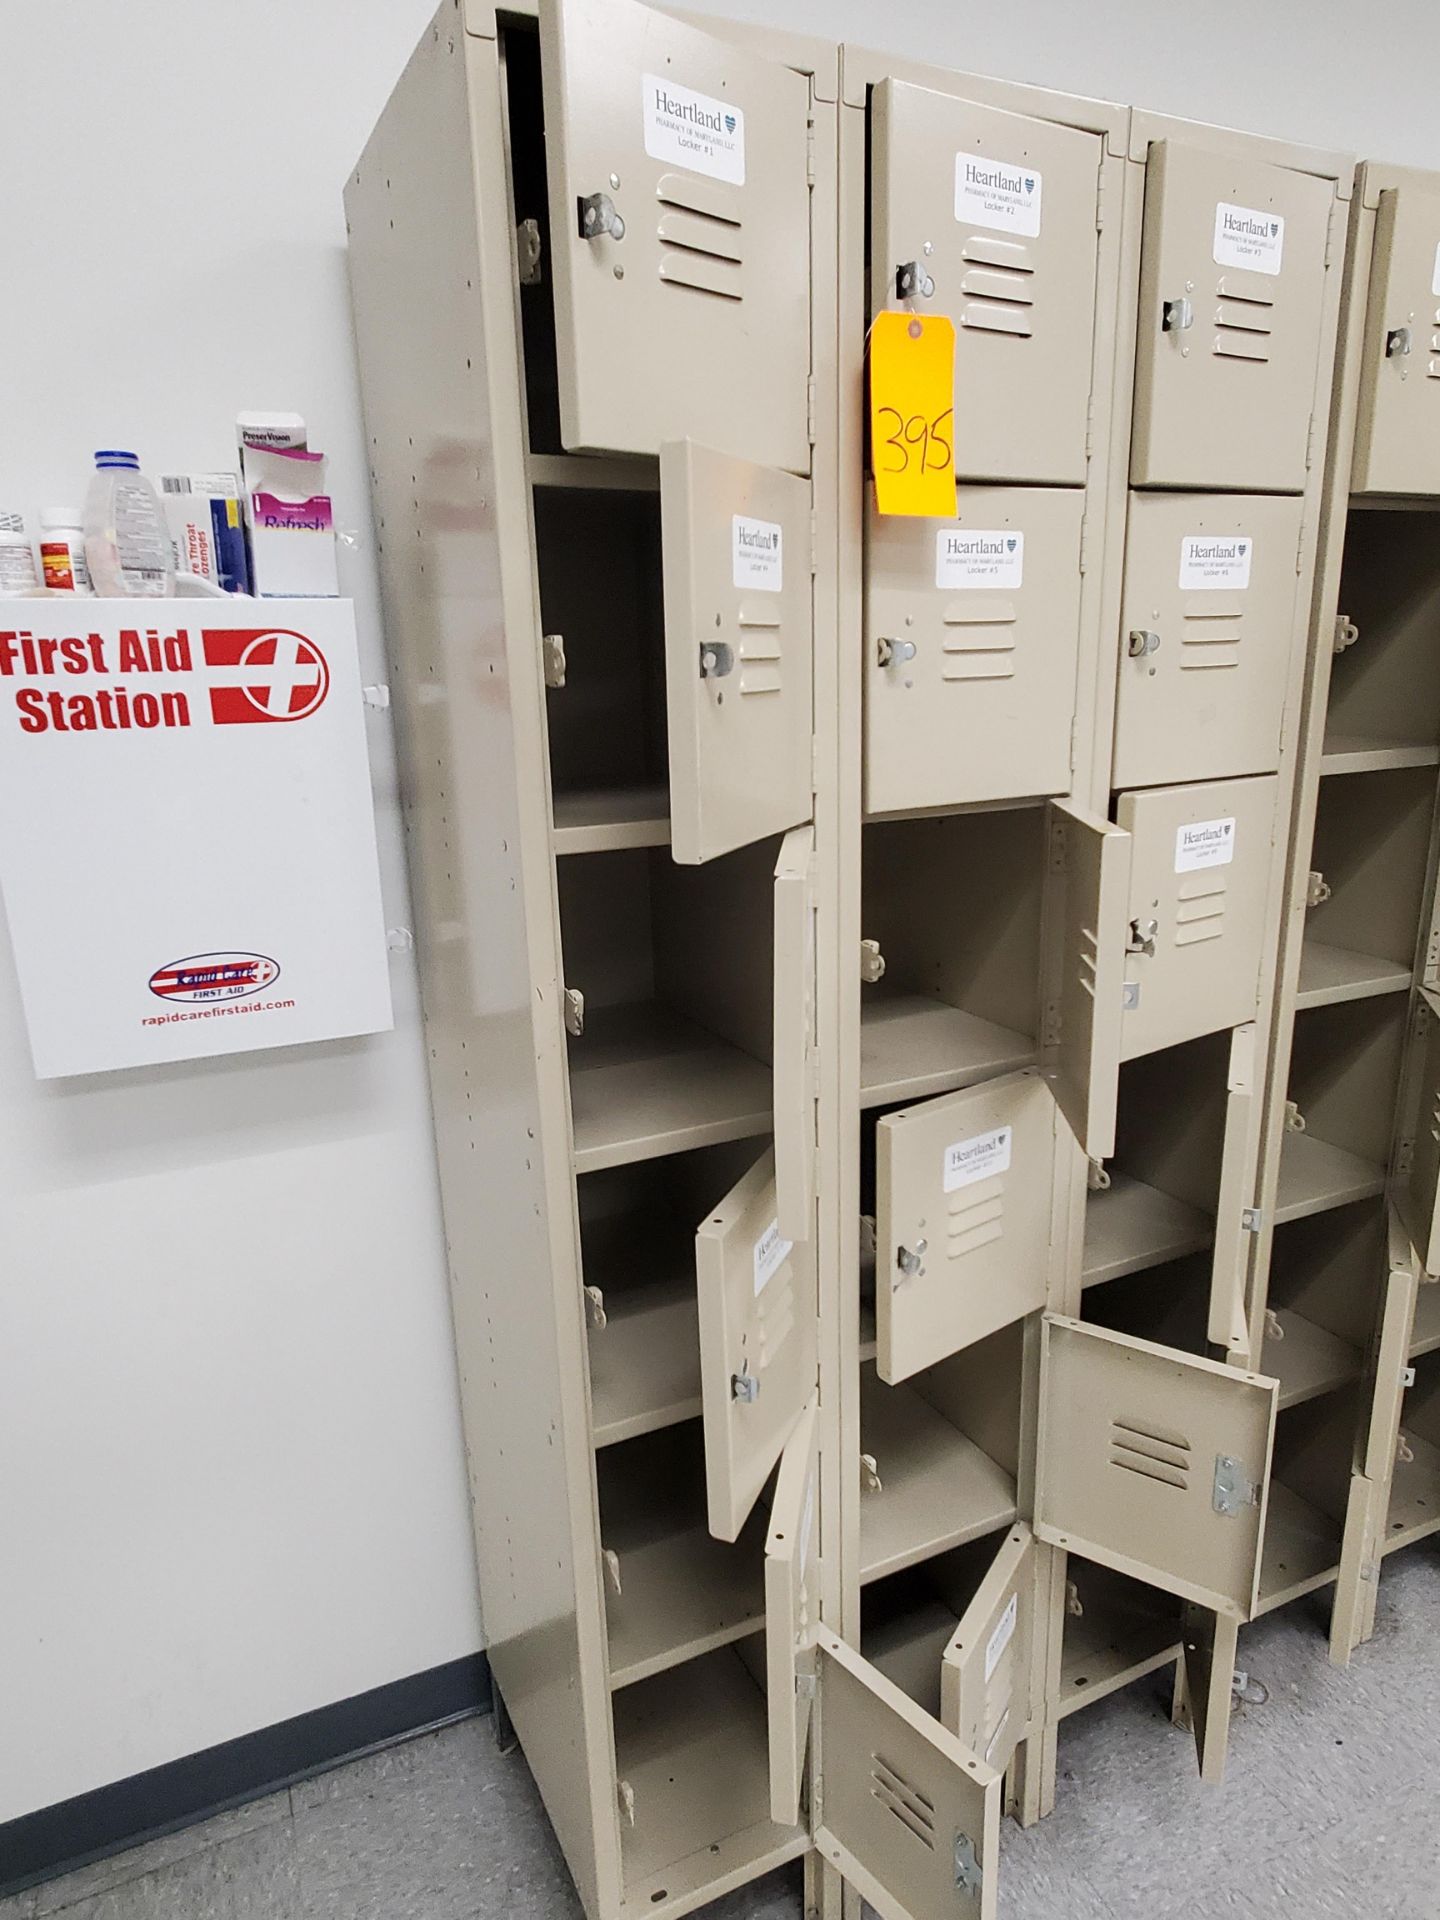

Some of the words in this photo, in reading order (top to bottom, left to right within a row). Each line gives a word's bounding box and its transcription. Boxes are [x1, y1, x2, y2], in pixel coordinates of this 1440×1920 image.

[655, 88, 722, 132] Heartland
[678, 135, 702, 153] Locker
[965, 163, 1022, 194] Heartland
[984, 201, 1005, 213] Locker
[1223, 212, 1269, 238] Heartland
[879, 407, 954, 475] 395
[186, 522, 198, 560] Throat
[738, 525, 772, 550] Heartland
[947, 538, 1004, 555] Heartland
[197, 530, 210, 576] ozenges
[1189, 544, 1236, 559] Heartland
[191, 561, 200, 575] re
[967, 565, 988, 575] Locker
[0, 630, 109, 676] First
[118, 629, 193, 673] Aid
[15, 686, 191, 734] Station
[1183, 825, 1223, 845] Heartland
[193, 987, 222, 999] FIRST
[225, 985, 245, 996] AID
[141, 999, 296, 1026] rapidcarefirstaid.com
